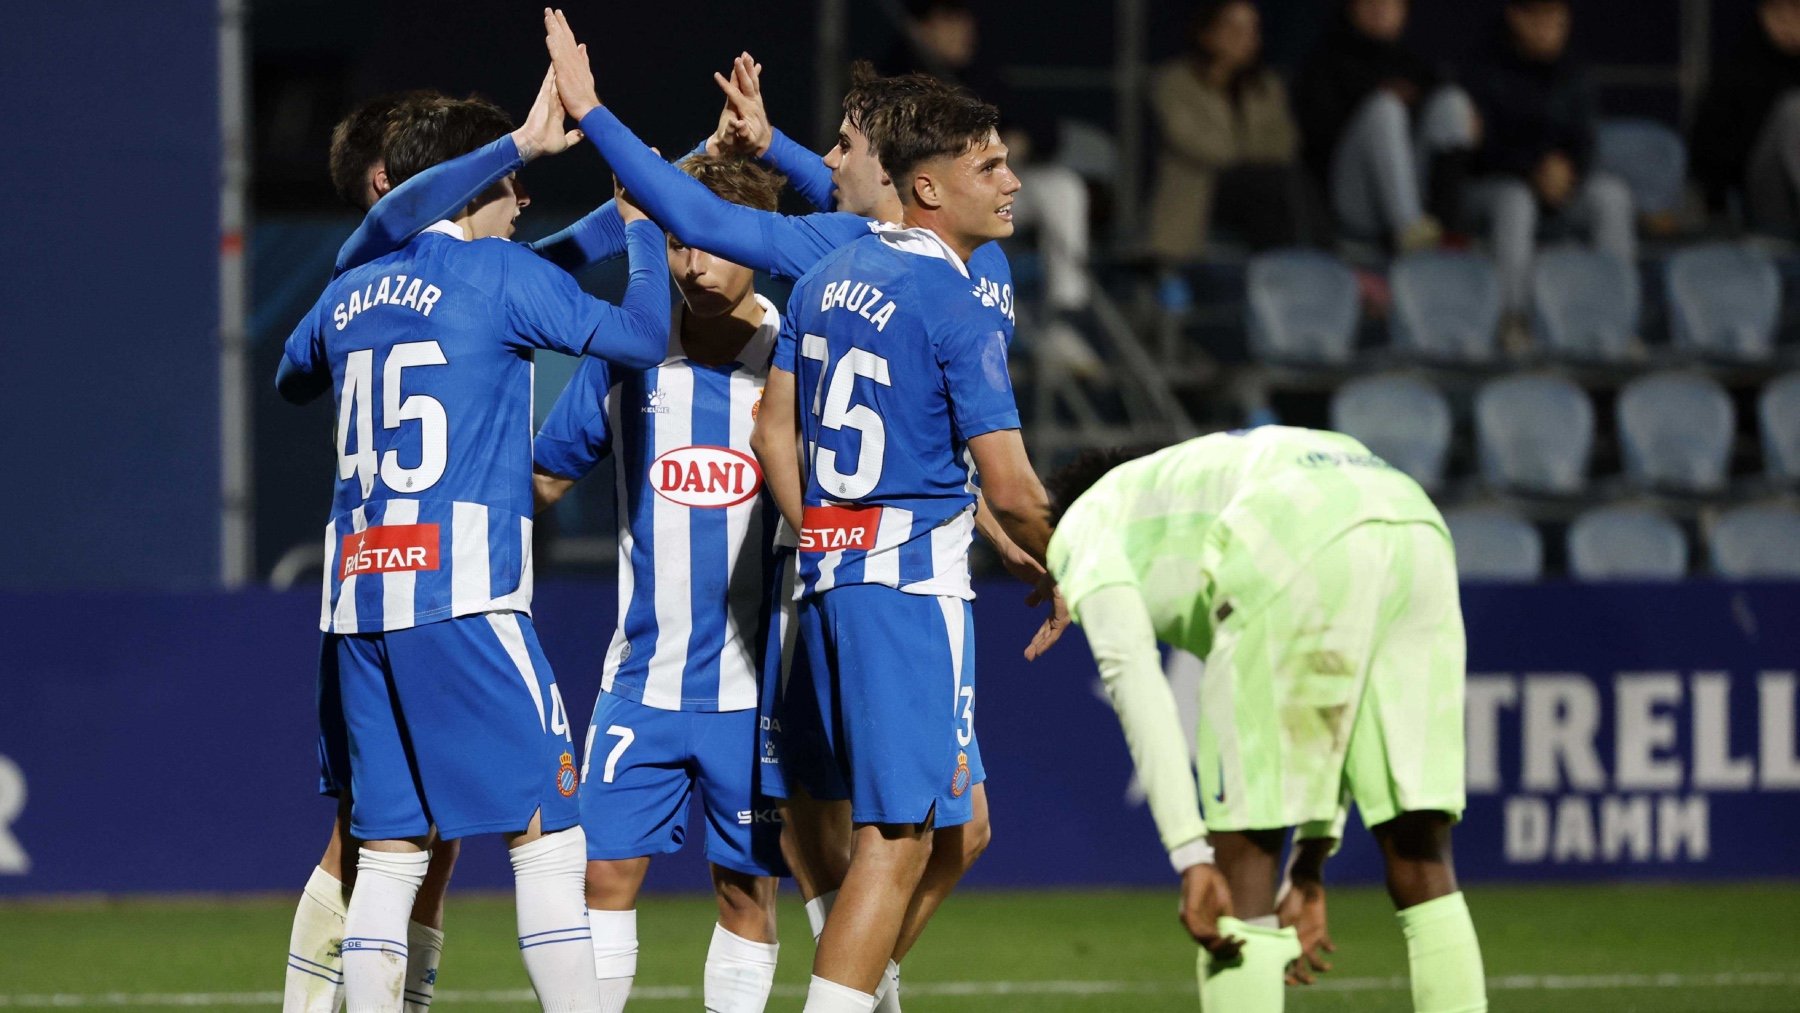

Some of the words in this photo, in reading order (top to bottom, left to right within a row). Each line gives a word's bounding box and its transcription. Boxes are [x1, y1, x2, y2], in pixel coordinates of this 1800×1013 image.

[334, 275, 441, 331] SALAZAR
[821, 280, 896, 332] BAUZA
[337, 340, 448, 500] 45
[660, 460, 745, 494] DANI
[799, 527, 865, 548] STAR
[957, 685, 973, 747] 3
[1504, 796, 1710, 862] DAMM
